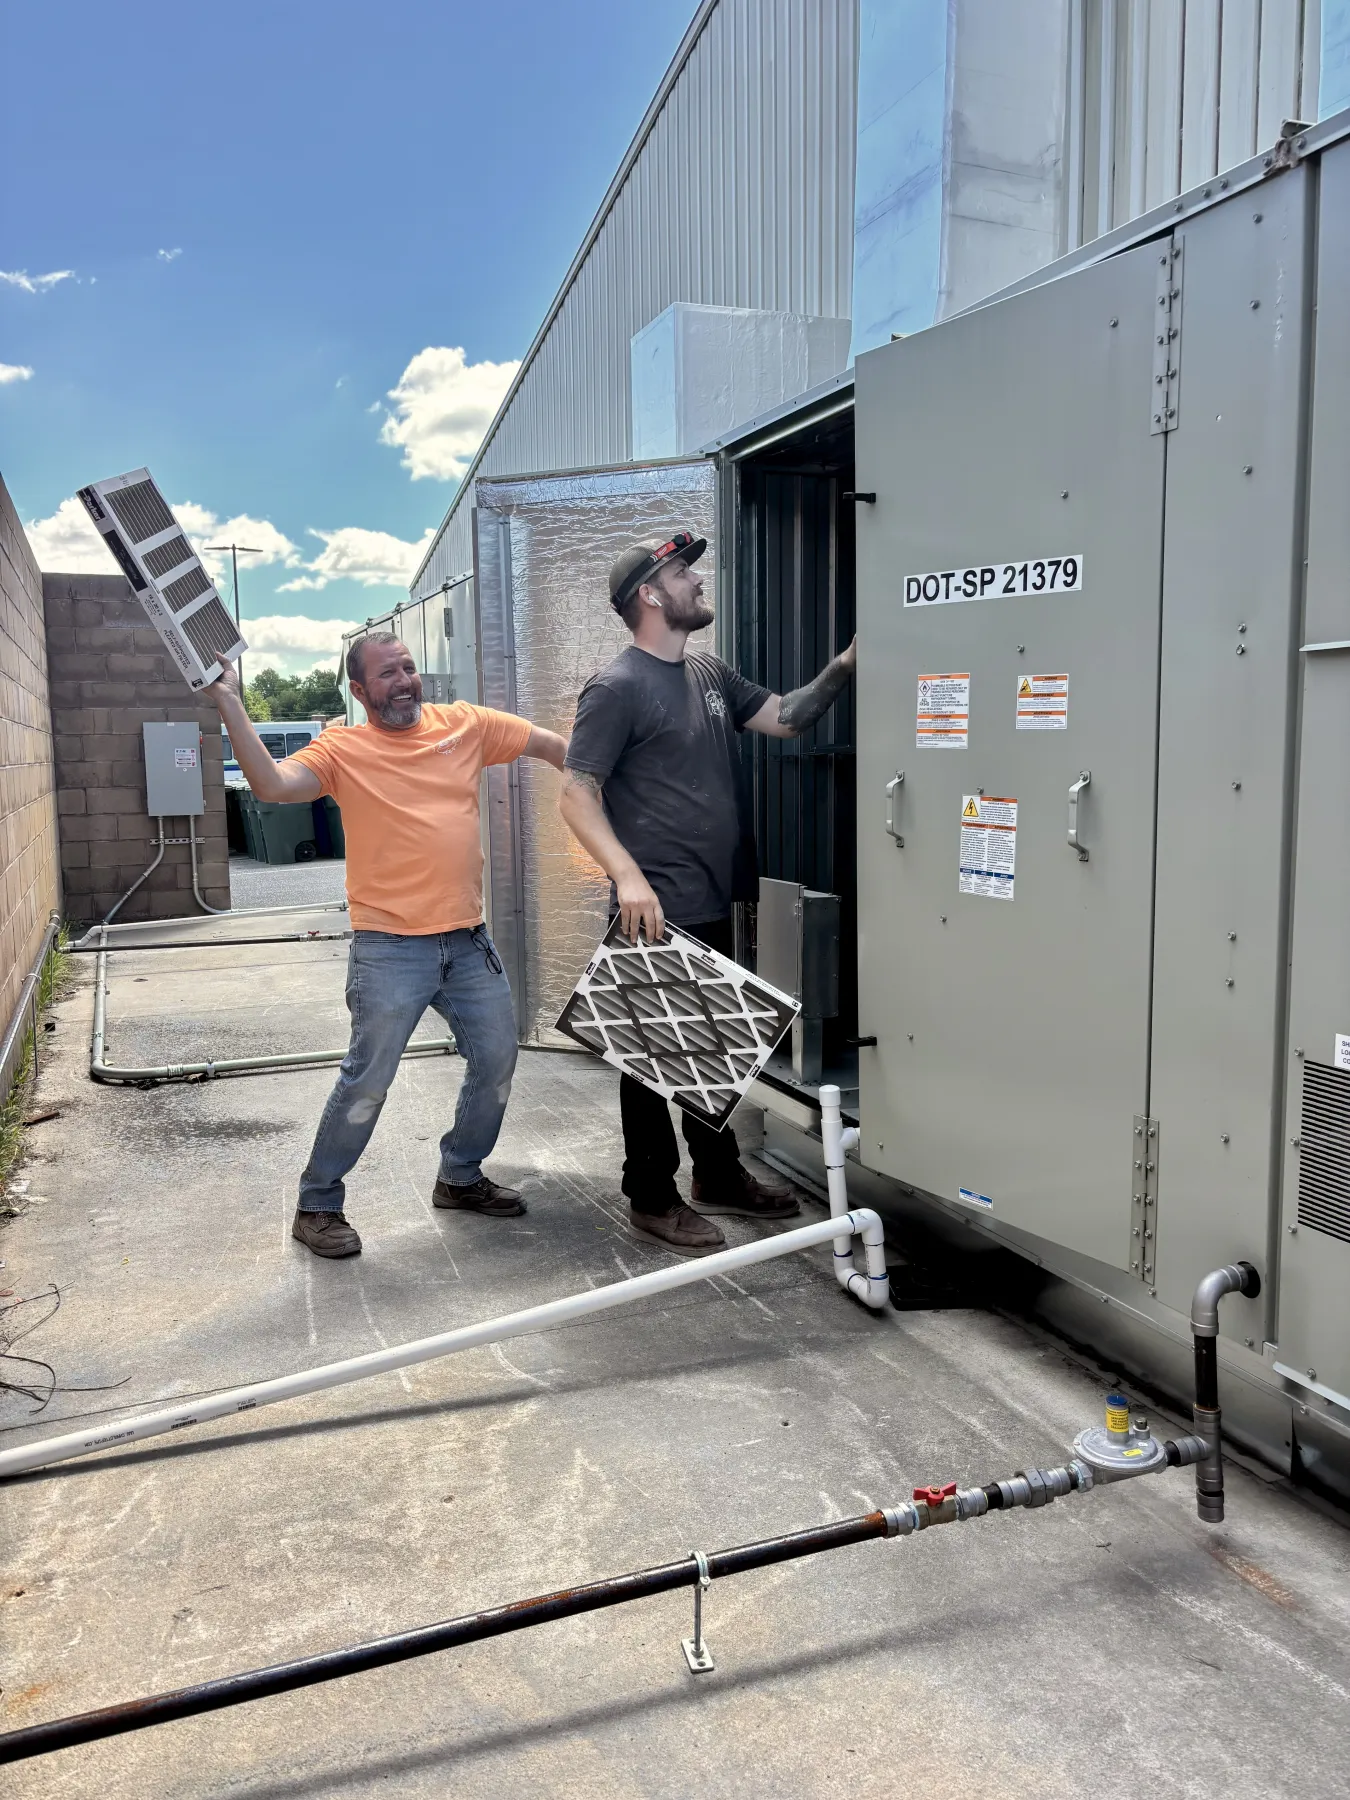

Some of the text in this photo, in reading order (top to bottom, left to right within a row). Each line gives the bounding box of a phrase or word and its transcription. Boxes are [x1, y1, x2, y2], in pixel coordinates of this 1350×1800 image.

[84, 495, 101, 520] Parker
[906, 557, 1078, 603] DOT-SP 21379
